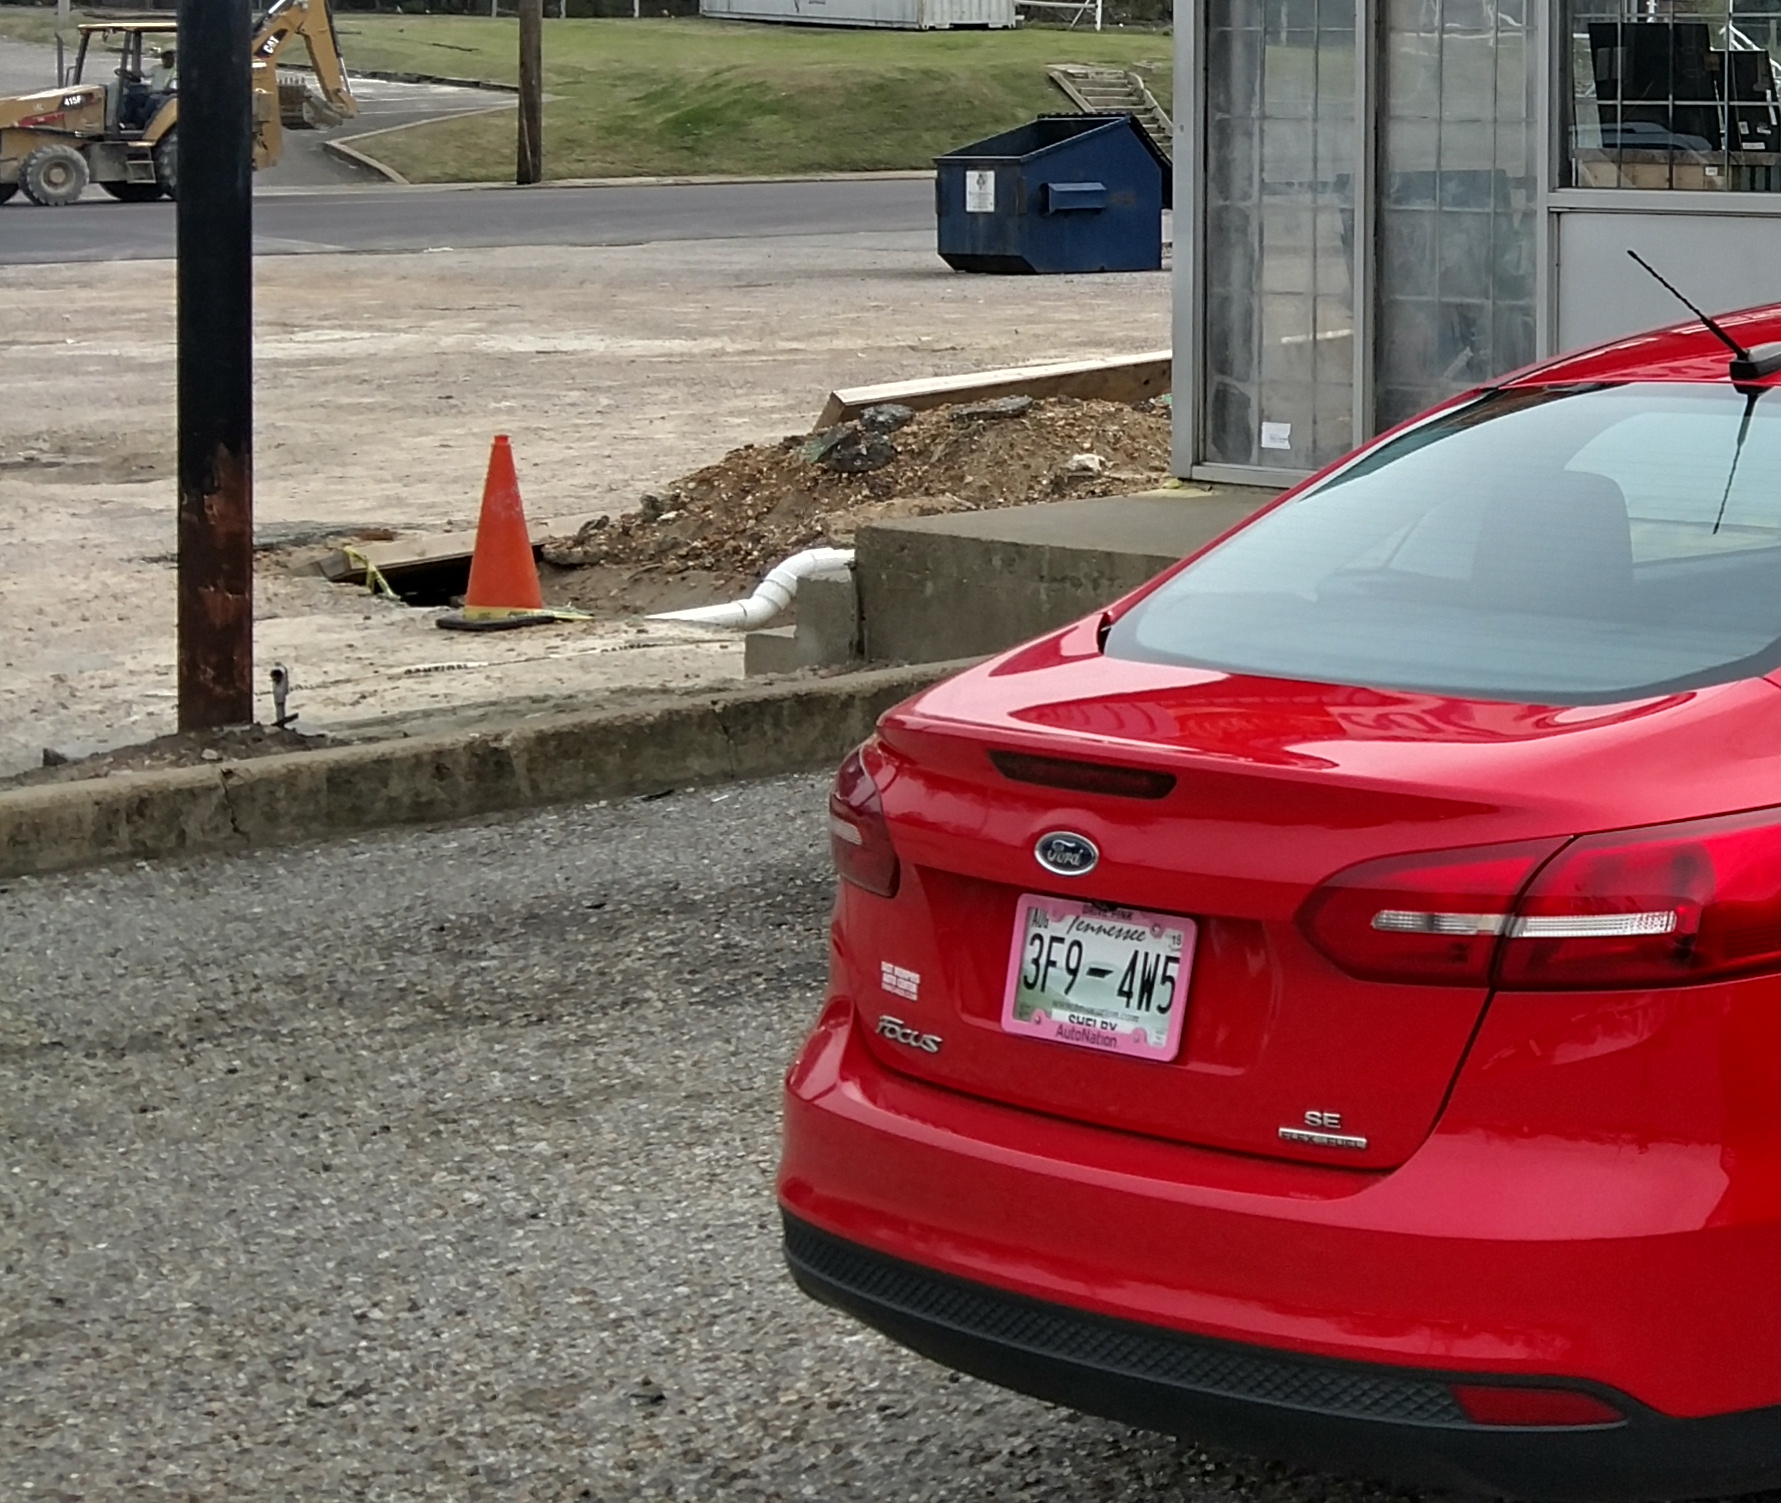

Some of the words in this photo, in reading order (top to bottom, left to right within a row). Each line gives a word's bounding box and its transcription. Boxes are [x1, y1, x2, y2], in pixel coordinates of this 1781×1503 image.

[263, 35, 280, 54] CAT
[1046, 839, 1084, 867] Ford
[1066, 915, 1146, 943] Tennessee
[1055, 1023, 1117, 1049] AutoNation
[1304, 1110, 1342, 1129] SE
